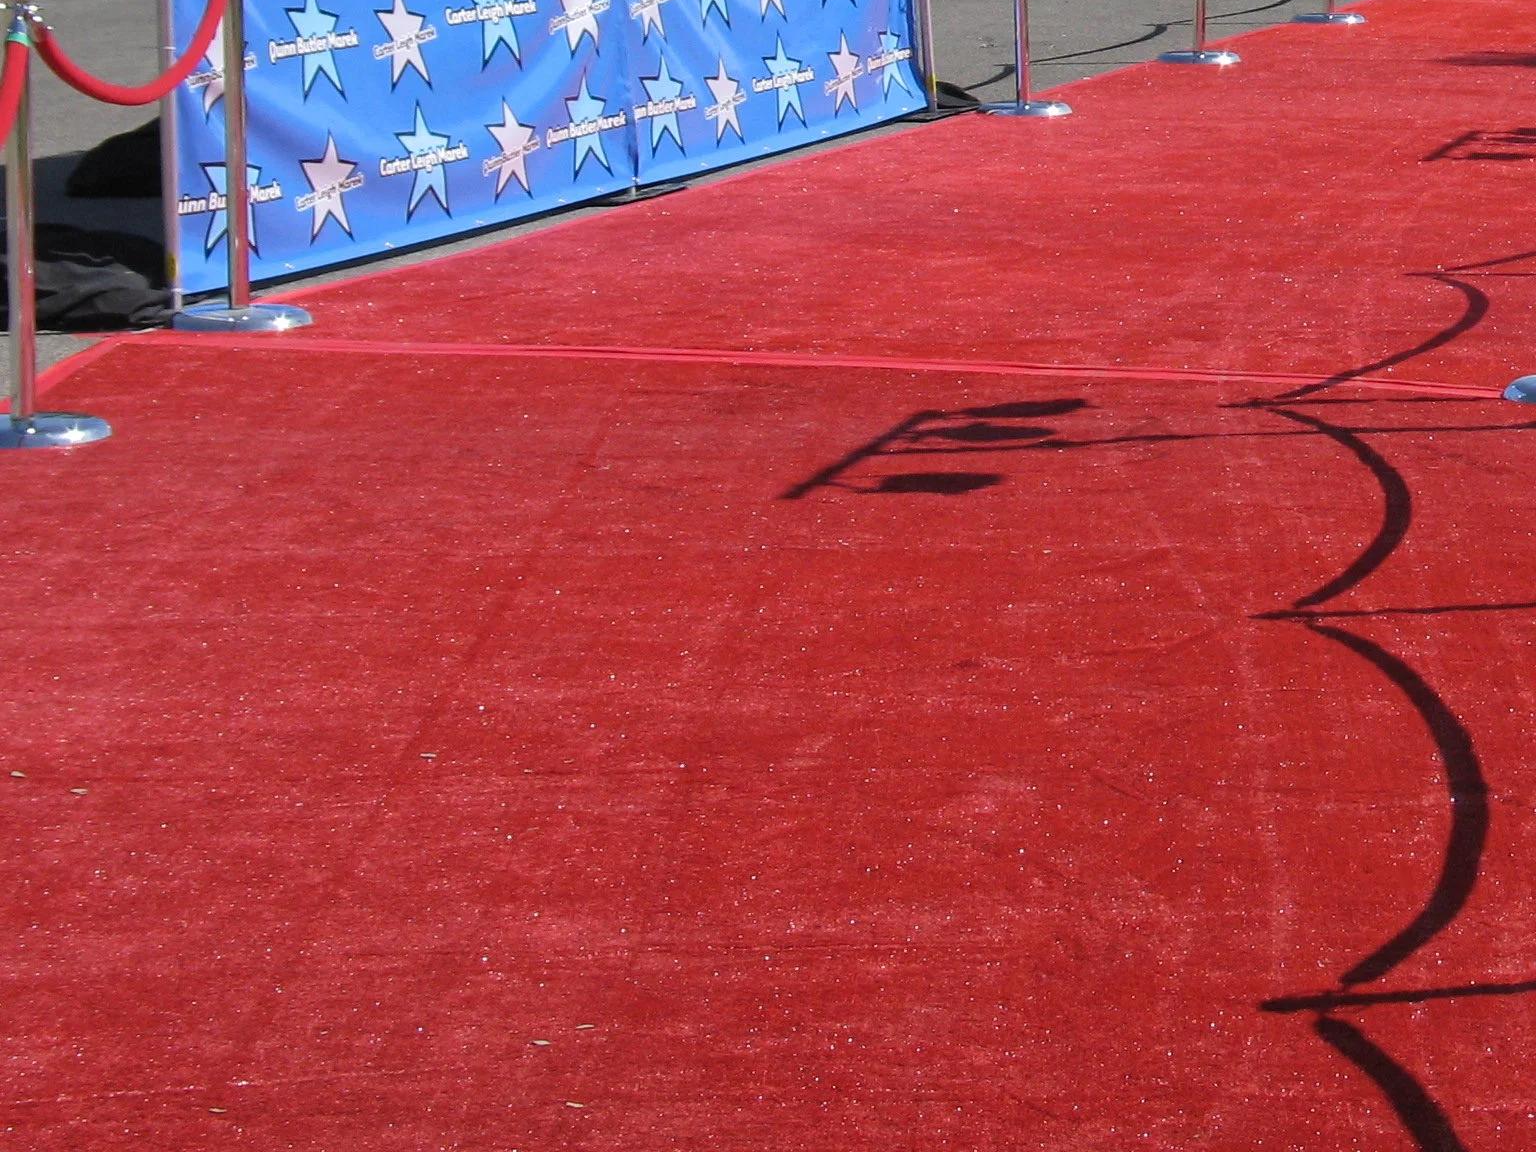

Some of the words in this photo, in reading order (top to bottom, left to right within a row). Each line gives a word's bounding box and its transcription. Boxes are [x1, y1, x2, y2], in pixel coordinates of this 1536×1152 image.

[446, 6, 476, 25] Carter
[477, 3, 504, 25] Leigh
[505, 0, 536, 18] Marek
[269, 39, 296, 63] Quinn
[297, 35, 326, 55] Butler
[328, 31, 358, 50] Marek
[753, 76, 773, 92] Carter
[794, 68, 815, 84] Marek
[547, 125, 569, 147] Quinn
[570, 119, 596, 139] Butler
[597, 112, 626, 132] Marek
[381, 154, 410, 175] Carter
[411, 149, 437, 173] Leigh
[438, 144, 468, 164] Marek
[251, 181, 282, 205] Marek
